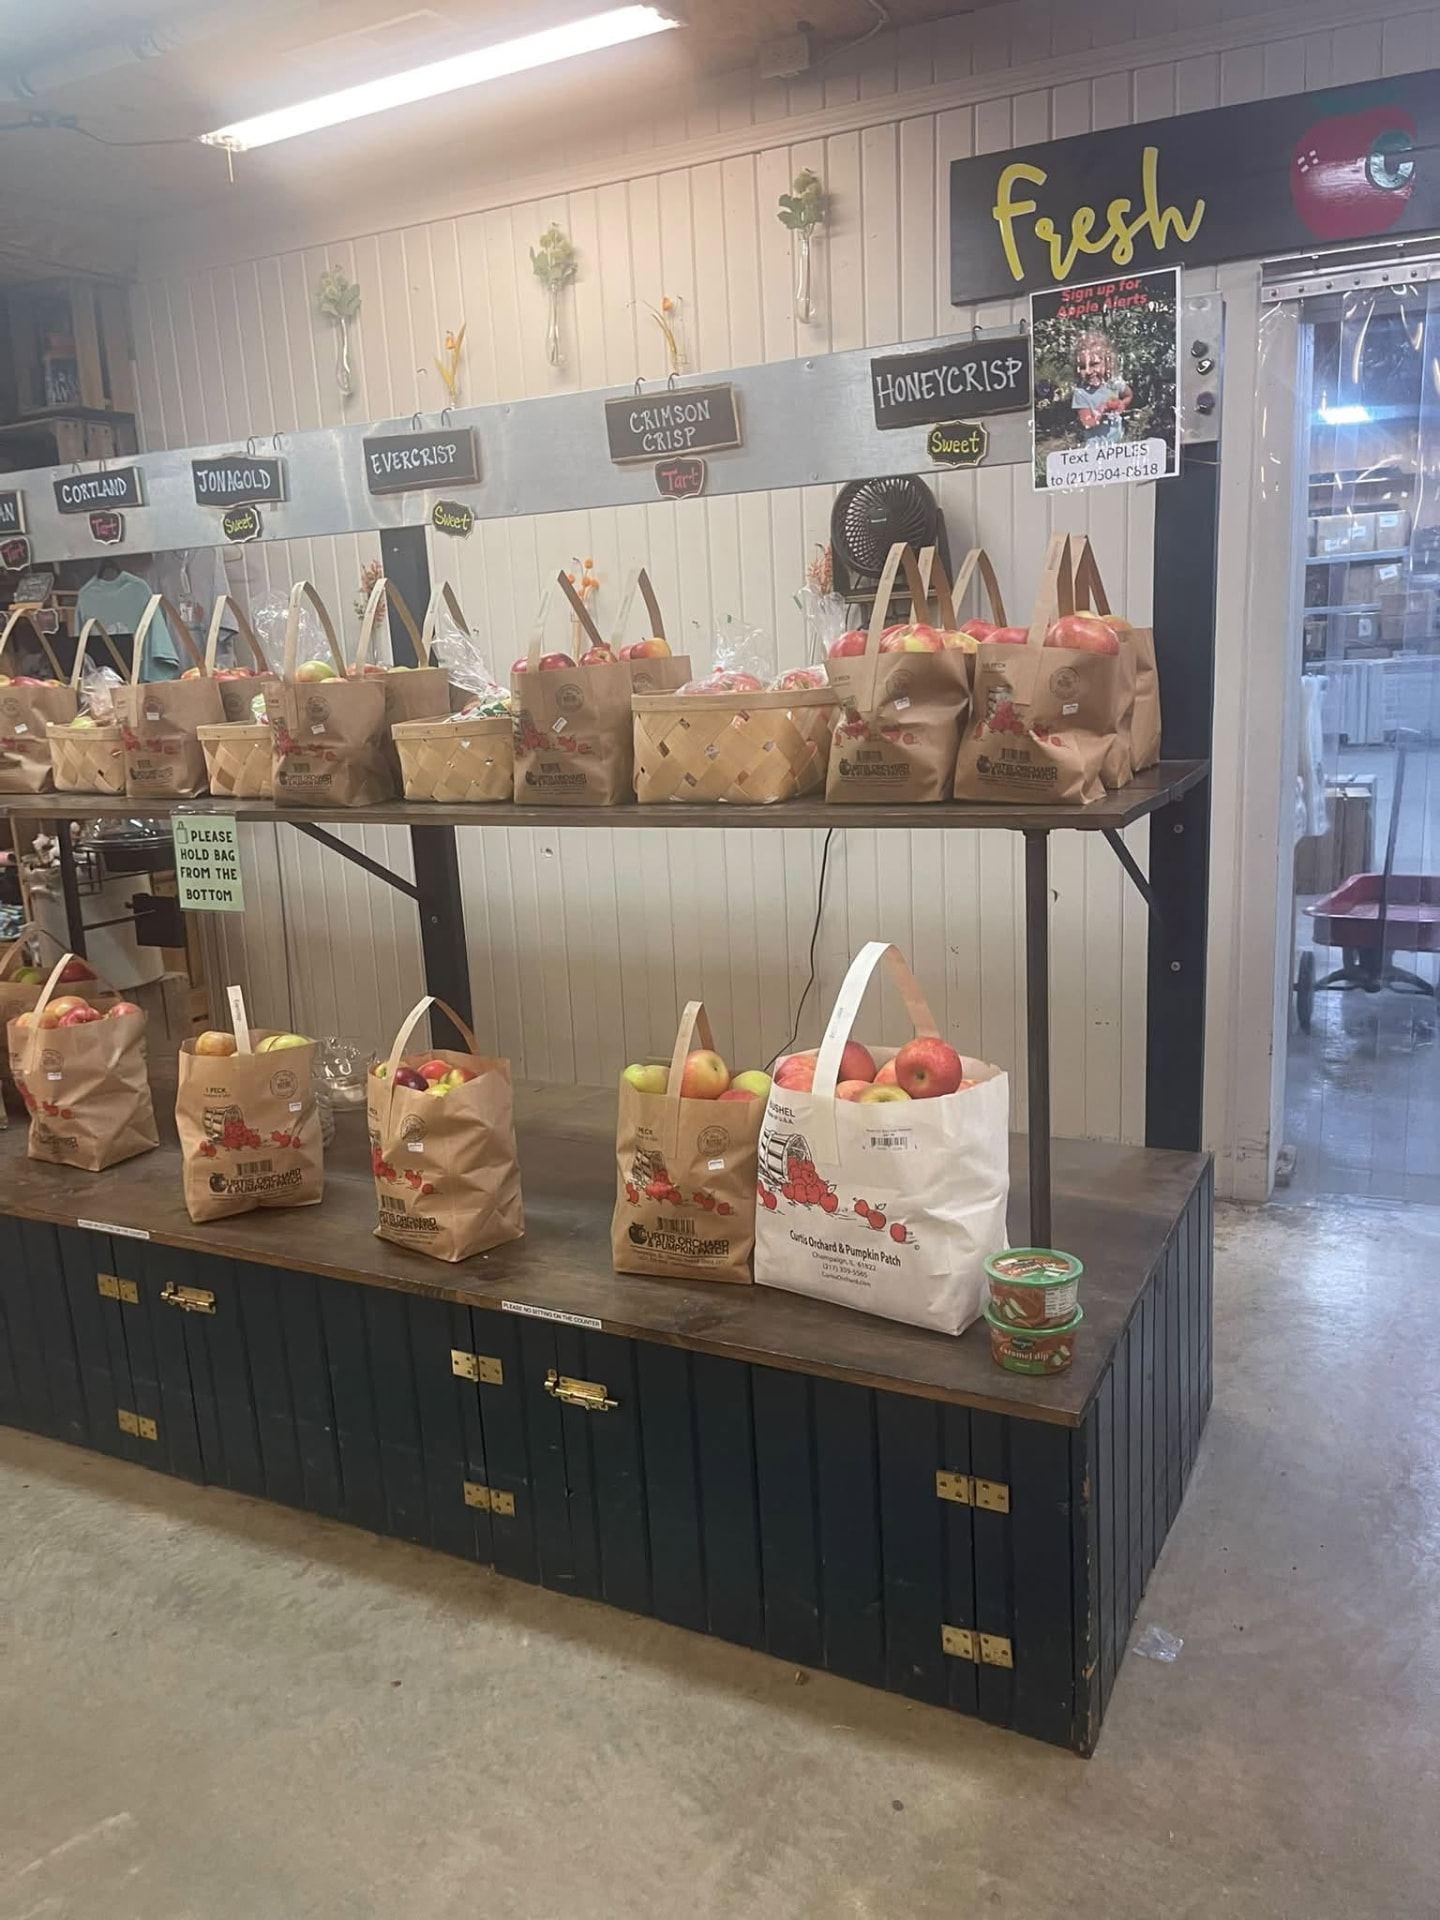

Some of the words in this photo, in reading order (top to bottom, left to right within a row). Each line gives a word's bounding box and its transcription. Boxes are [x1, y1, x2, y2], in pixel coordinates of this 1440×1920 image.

[992, 146, 1206, 281] Fresh
[1061, 288, 1093, 302] Sign
[1097, 284, 1115, 297] up
[1119, 278, 1142, 290] for
[1056, 301, 1098, 318] Apple
[1104, 293, 1148, 309] Alerts
[876, 357, 1022, 408] HONEYCRISP
[630, 399, 711, 433] CRIMSON
[642, 426, 696, 451] CRISP
[931, 431, 980, 454] Sweet
[371, 444, 457, 475] EVERCRISP
[1061, 453, 1089, 465] Text
[1096, 443, 1148, 461] APPLES
[62, 477, 127, 503] CORTLAND
[196, 469, 271, 493] JONAGOLD
[661, 466, 699, 491] Tart
[1051, 476, 1063, 486] to
[91, 518, 117, 537] Tart
[224, 513, 254, 534] Sweet
[434, 505, 470, 531] Sweet
[191, 830, 233, 843] PLEASE
[180, 849, 209, 860] HOLD
[214, 849, 235, 861] BAG
[180, 866, 211, 879] FROM
[216, 867, 237, 880] THE
[186, 888, 233, 902] BOTTOM
[790, 1230, 808, 1245] Curtis
[808, 1236, 837, 1252] Orchard
[838, 1243, 845, 1253] &
[846, 1244, 879, 1261] Pumpkin
[880, 1251, 901, 1267] Patch
[503, 1302, 522, 1311] PLEASE
[532, 1308, 553, 1317] SITTING
[573, 1316, 600, 1327] COUNTER
